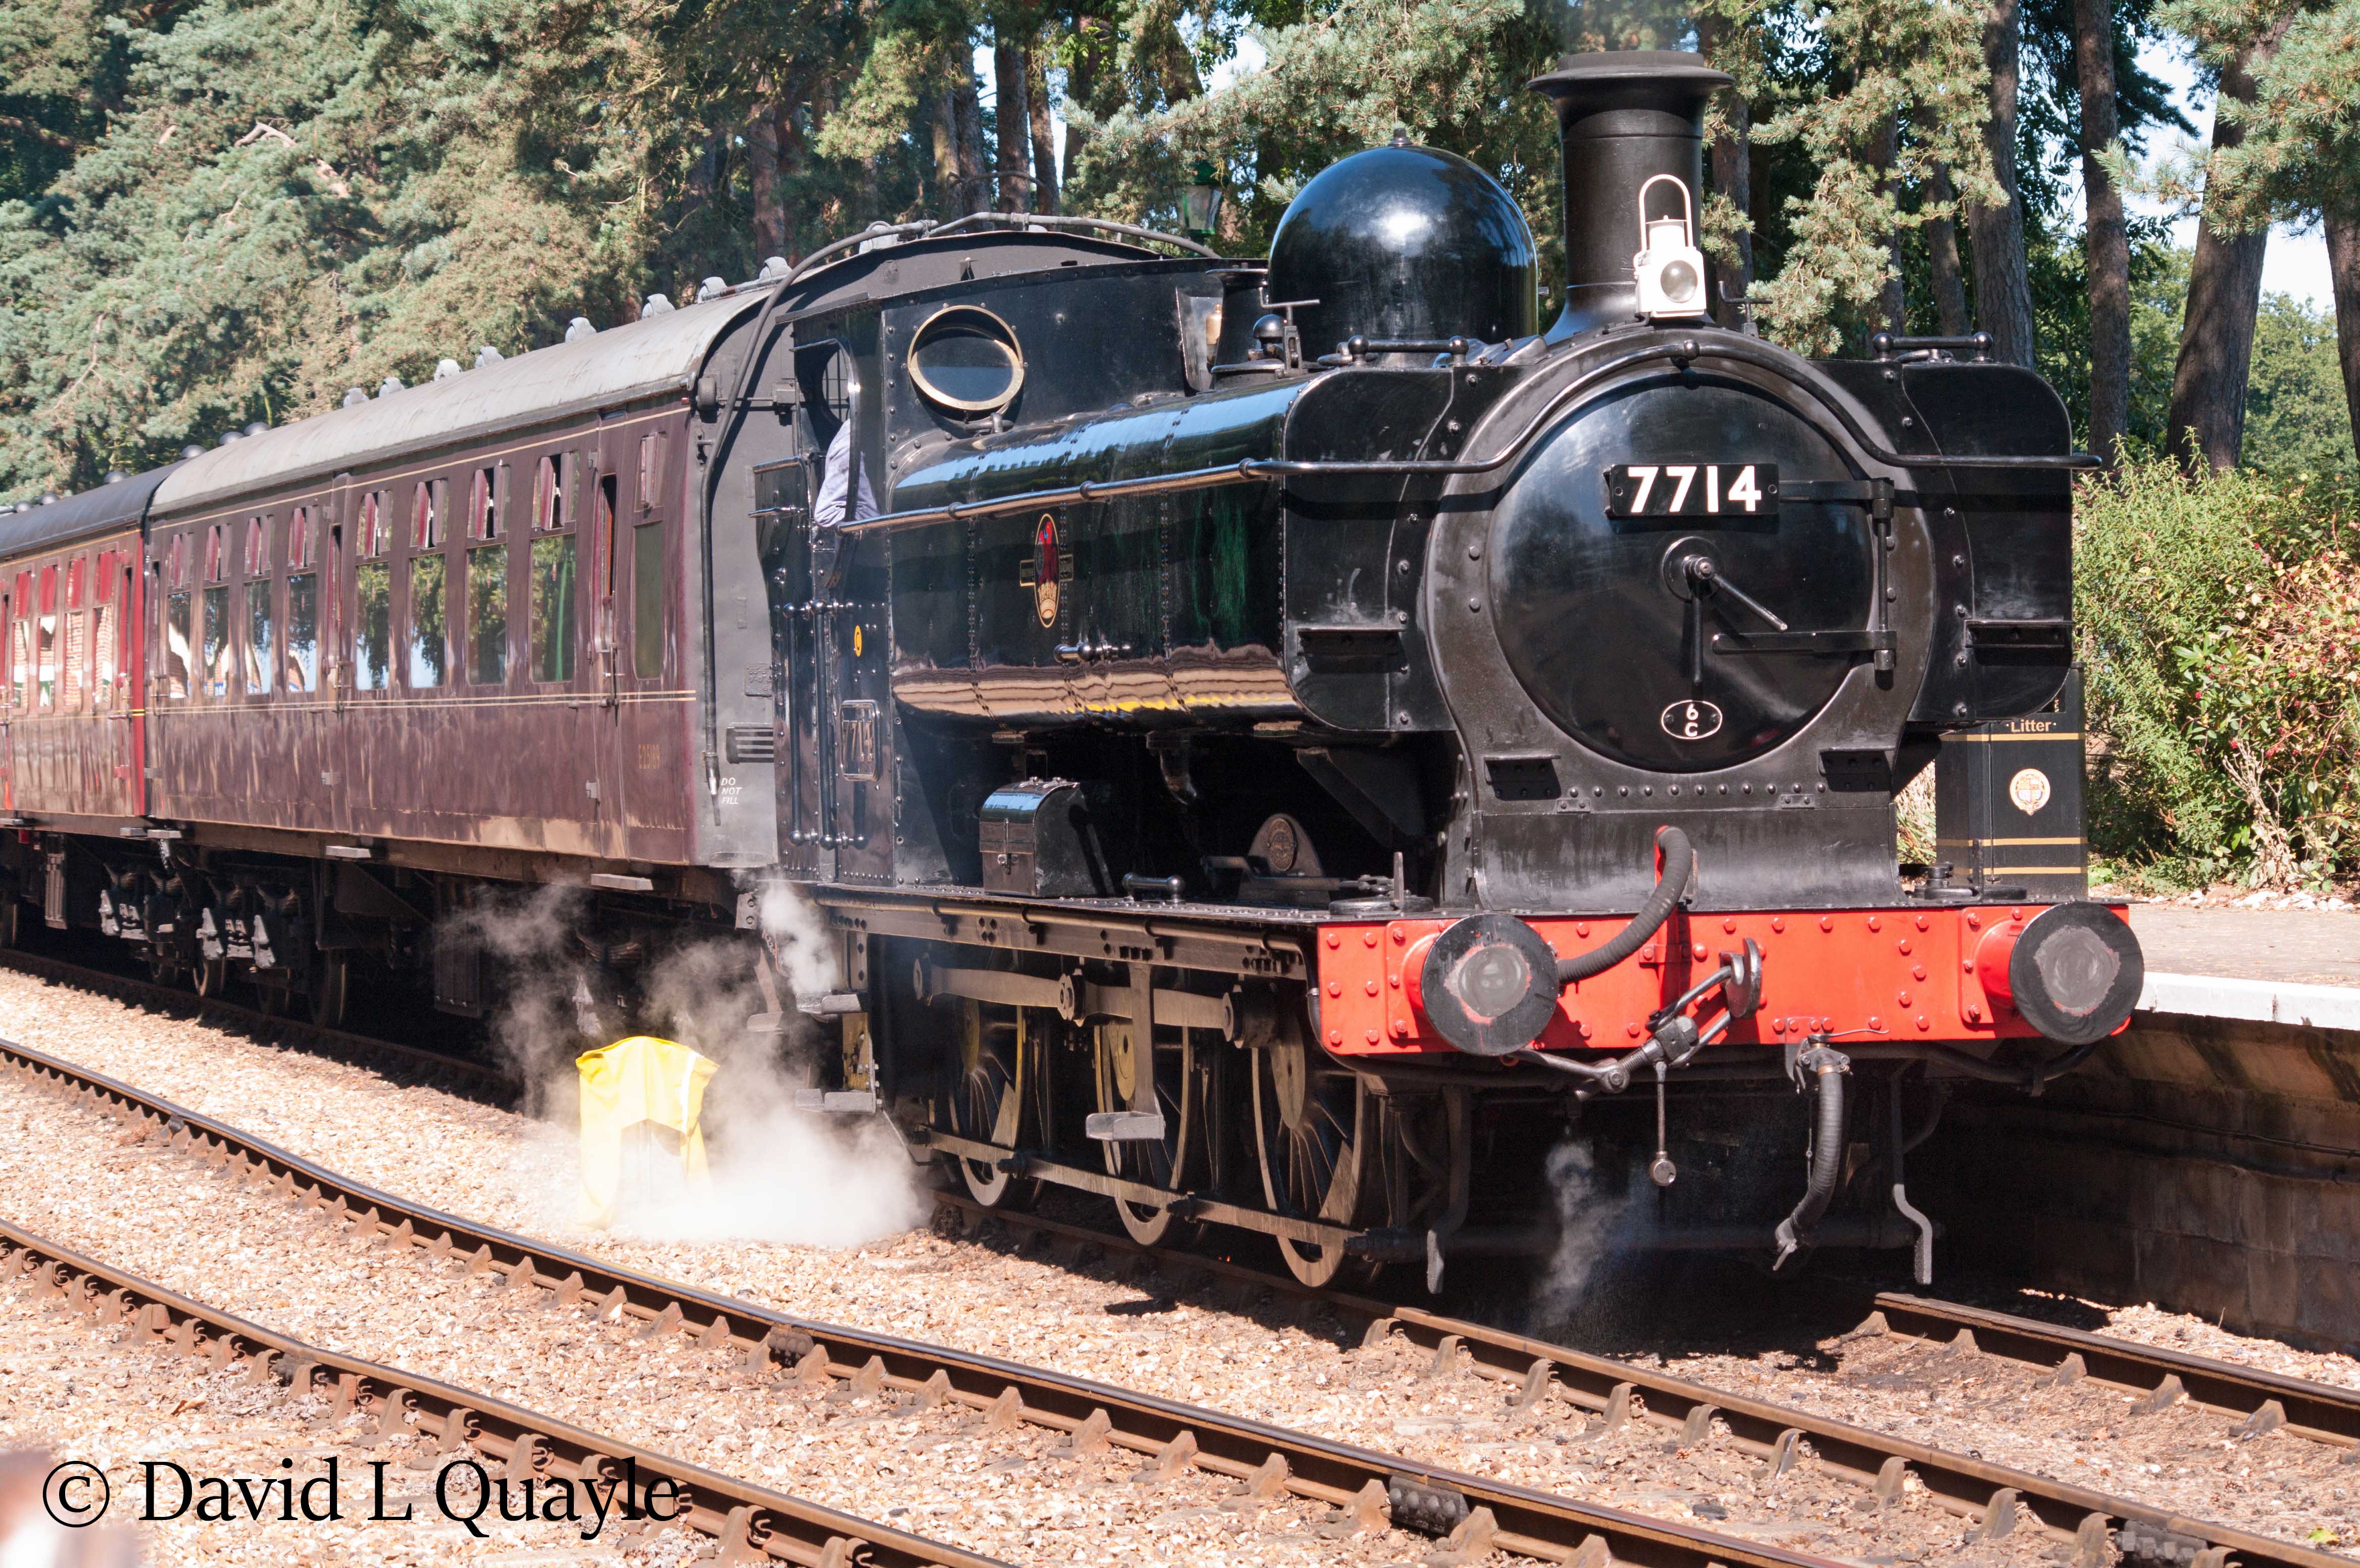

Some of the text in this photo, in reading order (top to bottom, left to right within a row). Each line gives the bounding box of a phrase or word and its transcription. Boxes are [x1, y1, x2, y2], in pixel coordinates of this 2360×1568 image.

[1628, 465, 1762, 513] 7714
[1686, 703, 1699, 721] 6
[1685, 721, 1698, 737] C
[2011, 719, 2052, 732] Litter
[721, 777, 736, 786] DO
[721, 787, 743, 795] NOT
[721, 796, 739, 805] FILL
